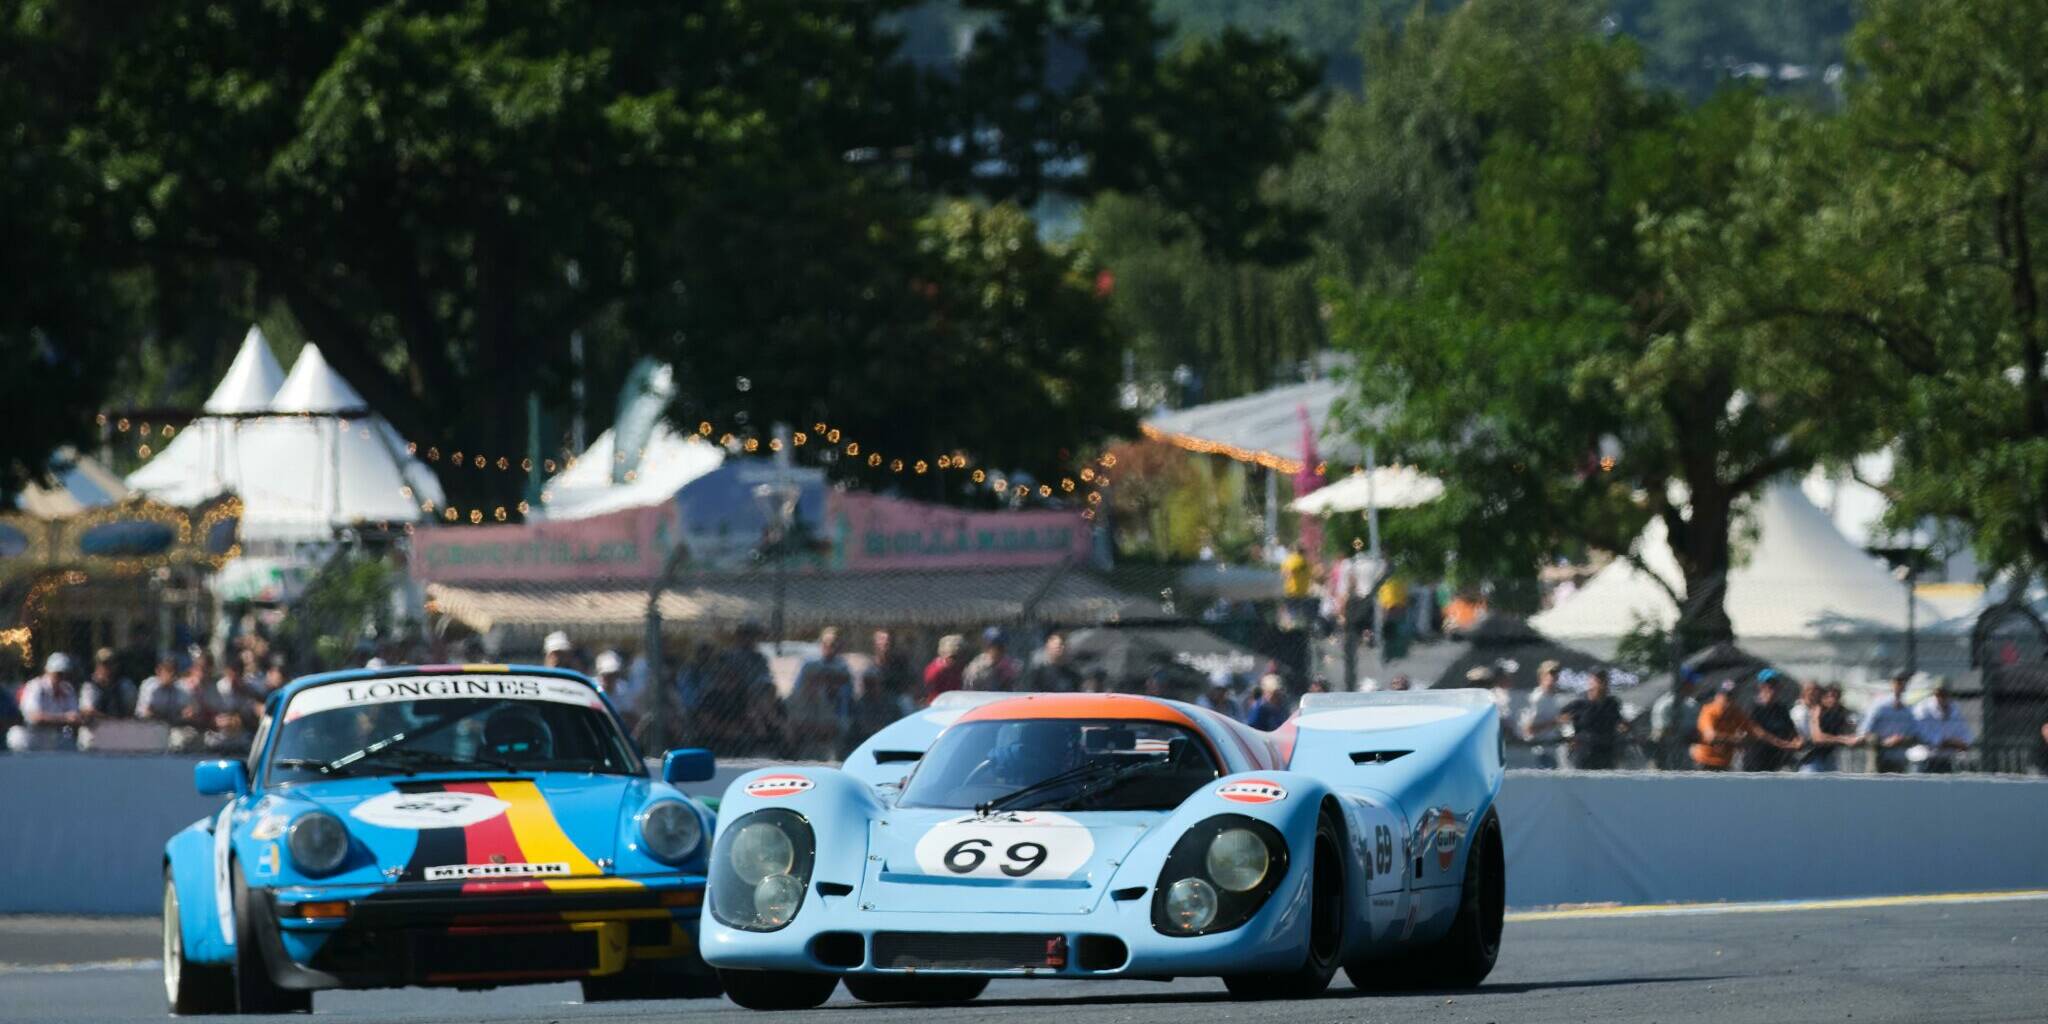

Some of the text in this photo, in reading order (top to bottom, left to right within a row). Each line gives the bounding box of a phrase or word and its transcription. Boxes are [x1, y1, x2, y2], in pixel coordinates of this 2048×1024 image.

[347, 679, 541, 701] LONGINES
[1219, 785, 1283, 796] Gulf
[1437, 830, 1457, 846] Gulf
[943, 838, 1048, 877] 69
[1375, 825, 1393, 875] 69
[434, 864, 562, 877] MICHELIN
